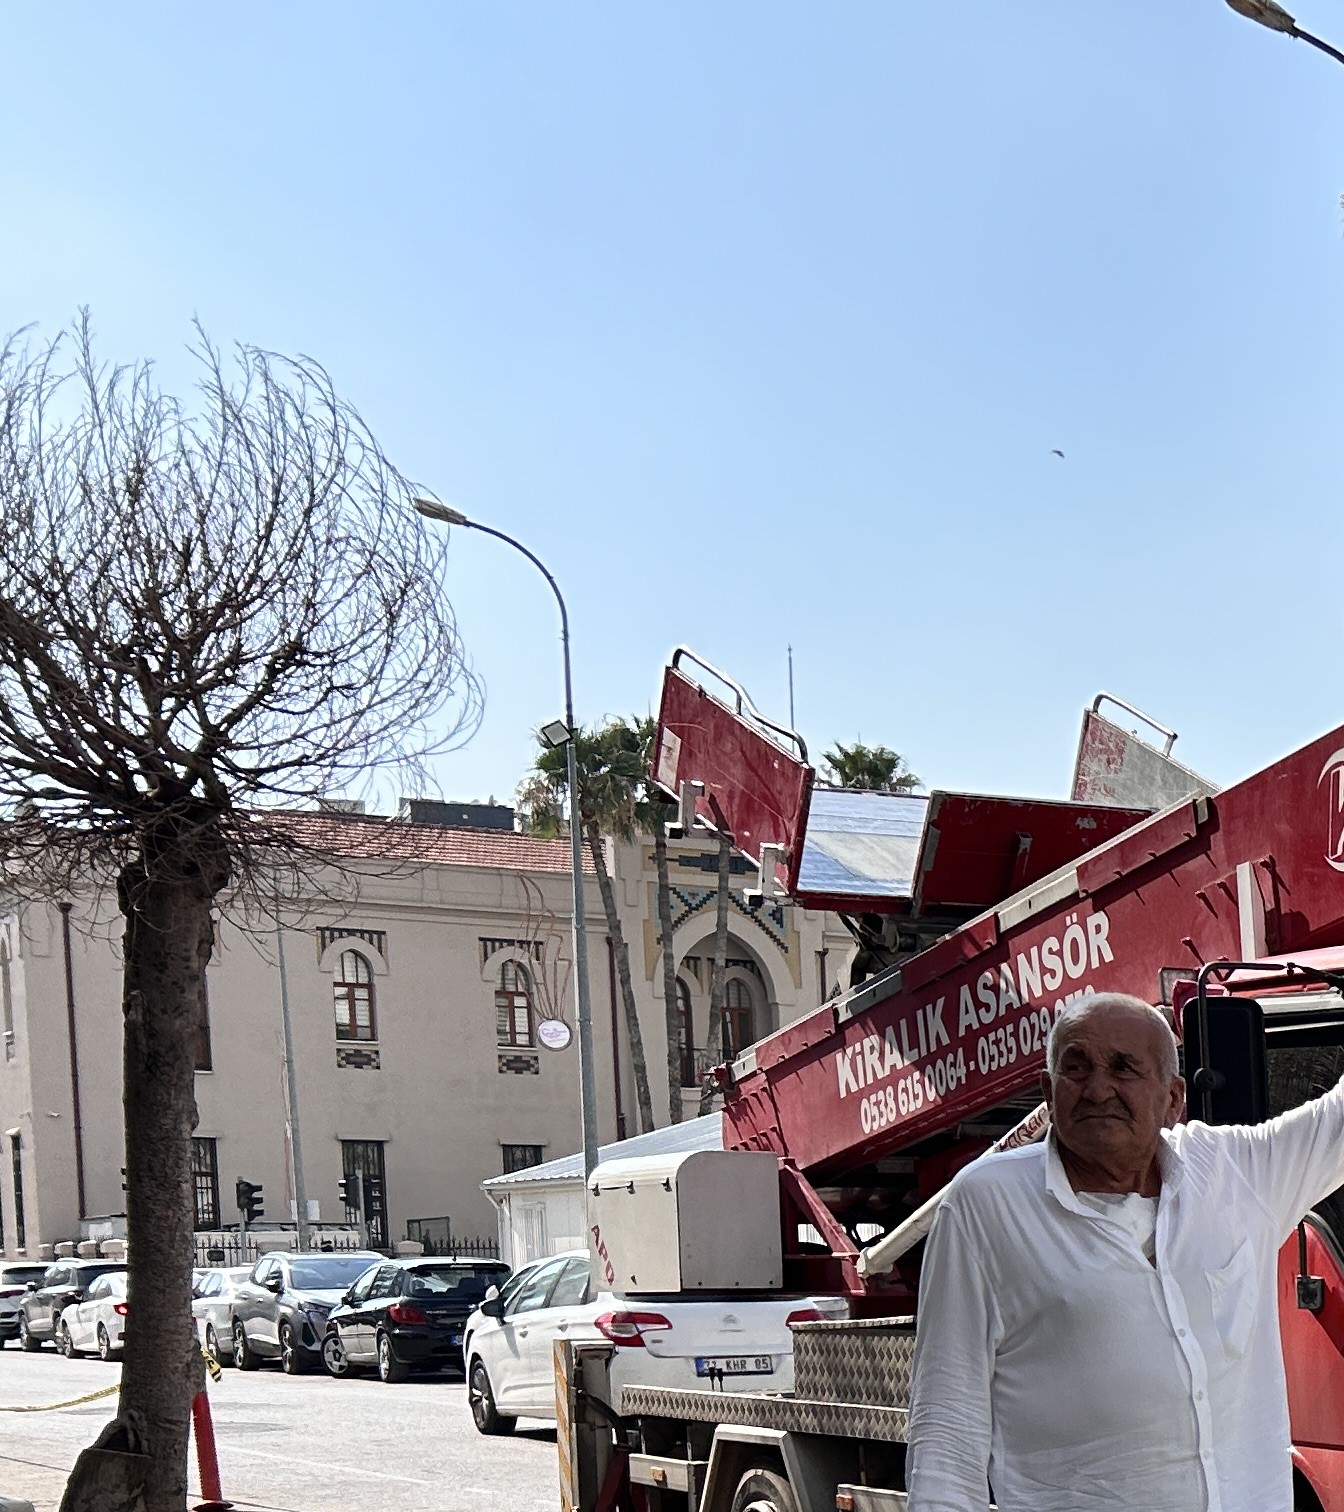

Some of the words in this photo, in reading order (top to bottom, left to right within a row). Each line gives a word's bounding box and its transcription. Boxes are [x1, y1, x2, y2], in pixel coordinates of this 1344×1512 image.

[957, 910, 1115, 1038] ASANSÖR
[860, 1085, 897, 1134] 0538
[899, 1070, 924, 1117] 615
[924, 1046, 967, 1102] 0064
[977, 1028, 1017, 1076] 0535
[1018, 1006, 1051, 1056] 029
